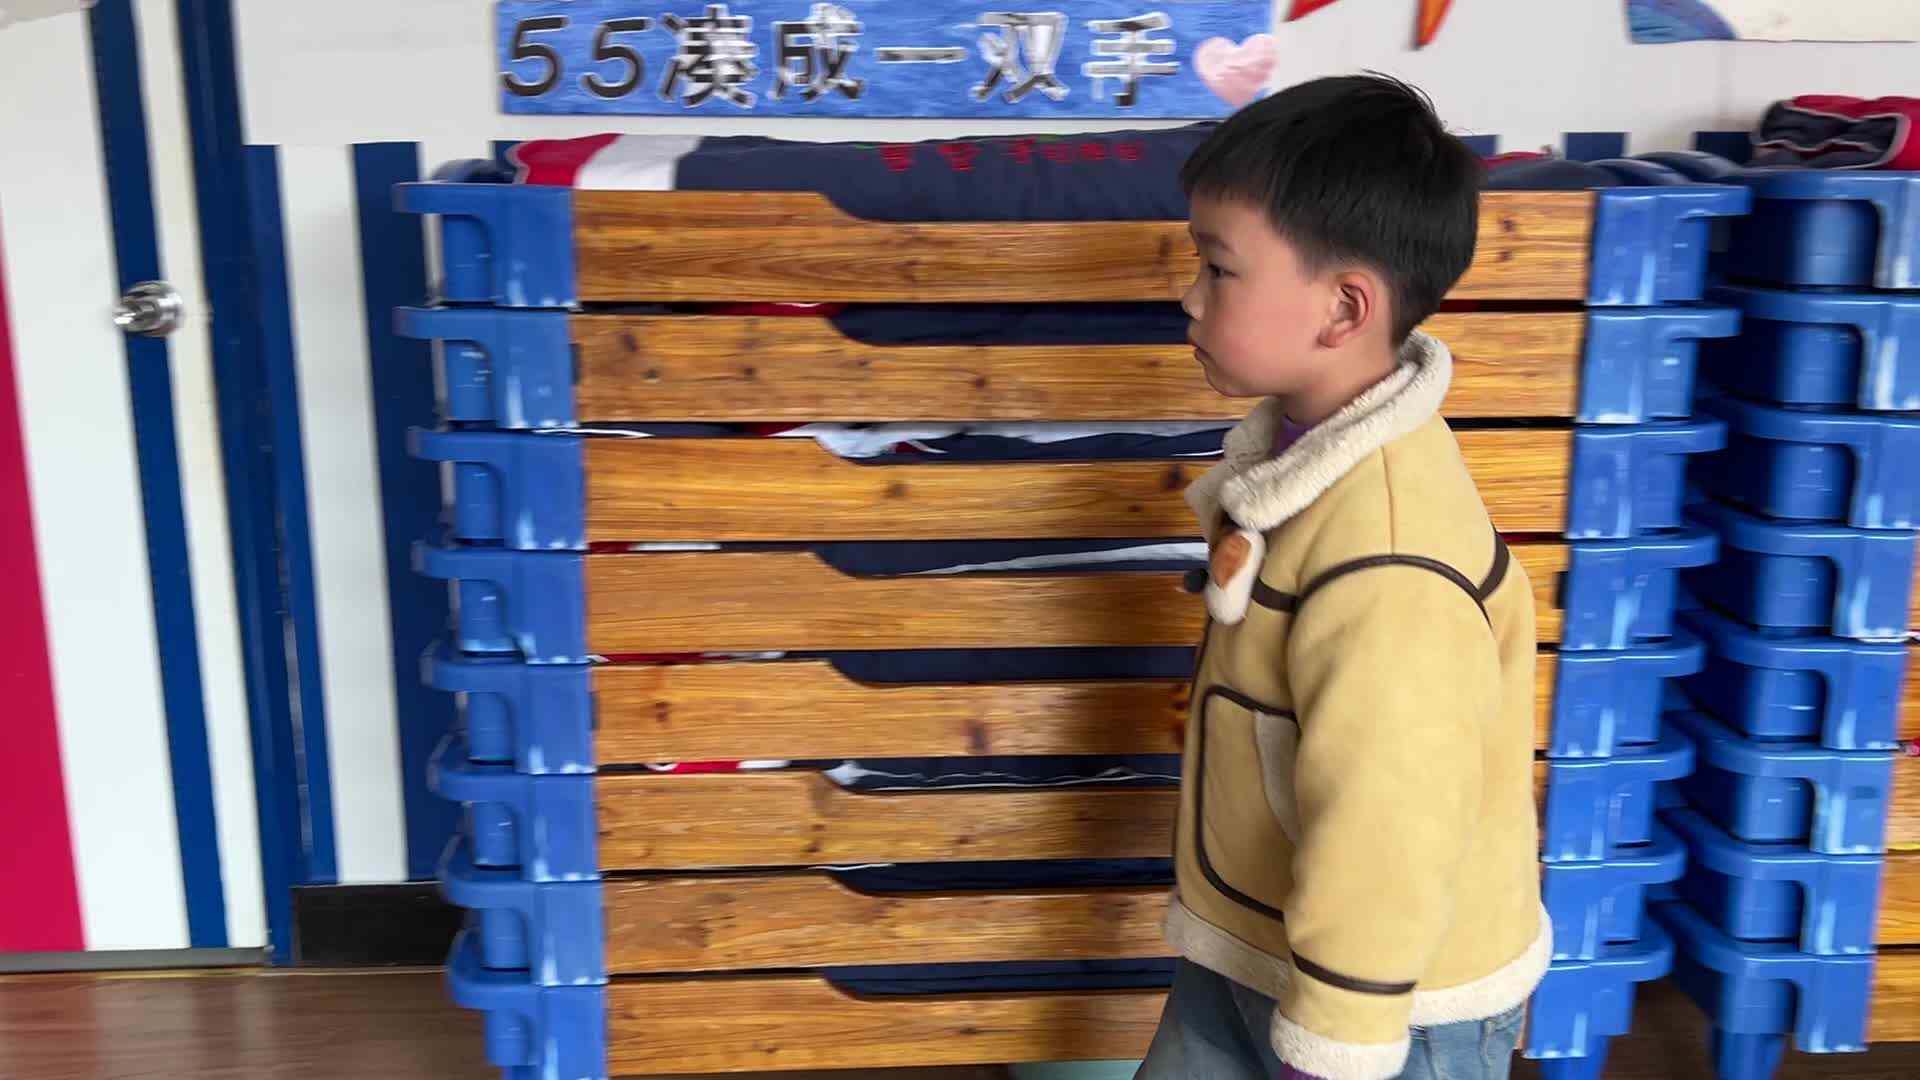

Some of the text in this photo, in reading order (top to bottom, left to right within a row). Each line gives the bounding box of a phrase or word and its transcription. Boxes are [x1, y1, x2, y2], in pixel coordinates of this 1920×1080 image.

[500, 3, 1180, 109] 55凑成一双手
